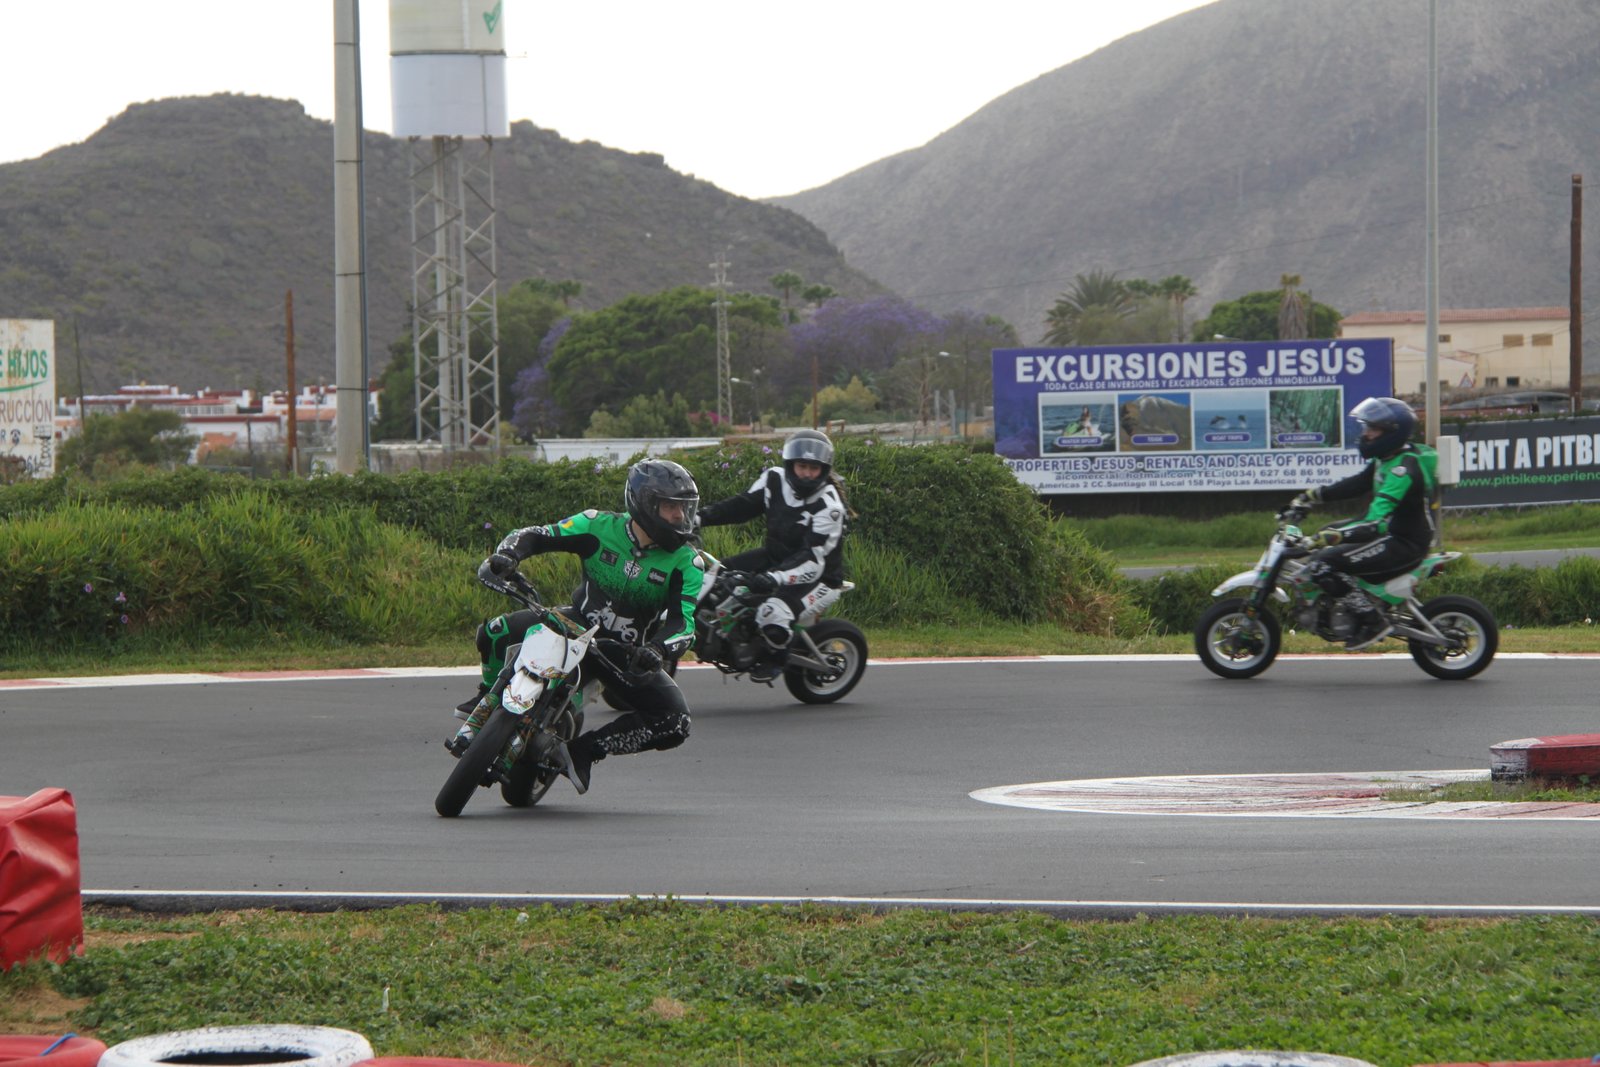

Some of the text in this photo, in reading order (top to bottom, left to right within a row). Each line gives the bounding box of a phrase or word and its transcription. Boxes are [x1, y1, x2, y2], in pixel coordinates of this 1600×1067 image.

[1016, 342, 1366, 382] EXCURSIONES JESÚS
[1045, 382, 1067, 391] TODA
[1068, 381, 1094, 390] CLASE
[1095, 381, 1107, 390] DE
[1108, 379, 1160, 389] INVERSIONES
[1161, 380, 1167, 388] Y
[1229, 376, 1273, 386] GESTIONES
[1274, 375, 1337, 385] INMOBILIARIAS
[1514, 438, 1531, 469] A
[1008, 460, 1090, 472] PROPERTIES
[1094, 458, 1135, 471] JESUS
[1146, 457, 1204, 469] RENTALS
[1208, 456, 1235, 468] AND
[1239, 456, 1272, 467] SALE
[1276, 456, 1293, 467] OF
[1260, 469, 1279, 477] 627
[1283, 468, 1297, 476] 68
[1300, 468, 1314, 476] 86
[1316, 468, 1330, 476] 99
[1039, 481, 1080, 489] Americas
[1160, 479, 1185, 487] Local
[1207, 479, 1232, 487] Playa
